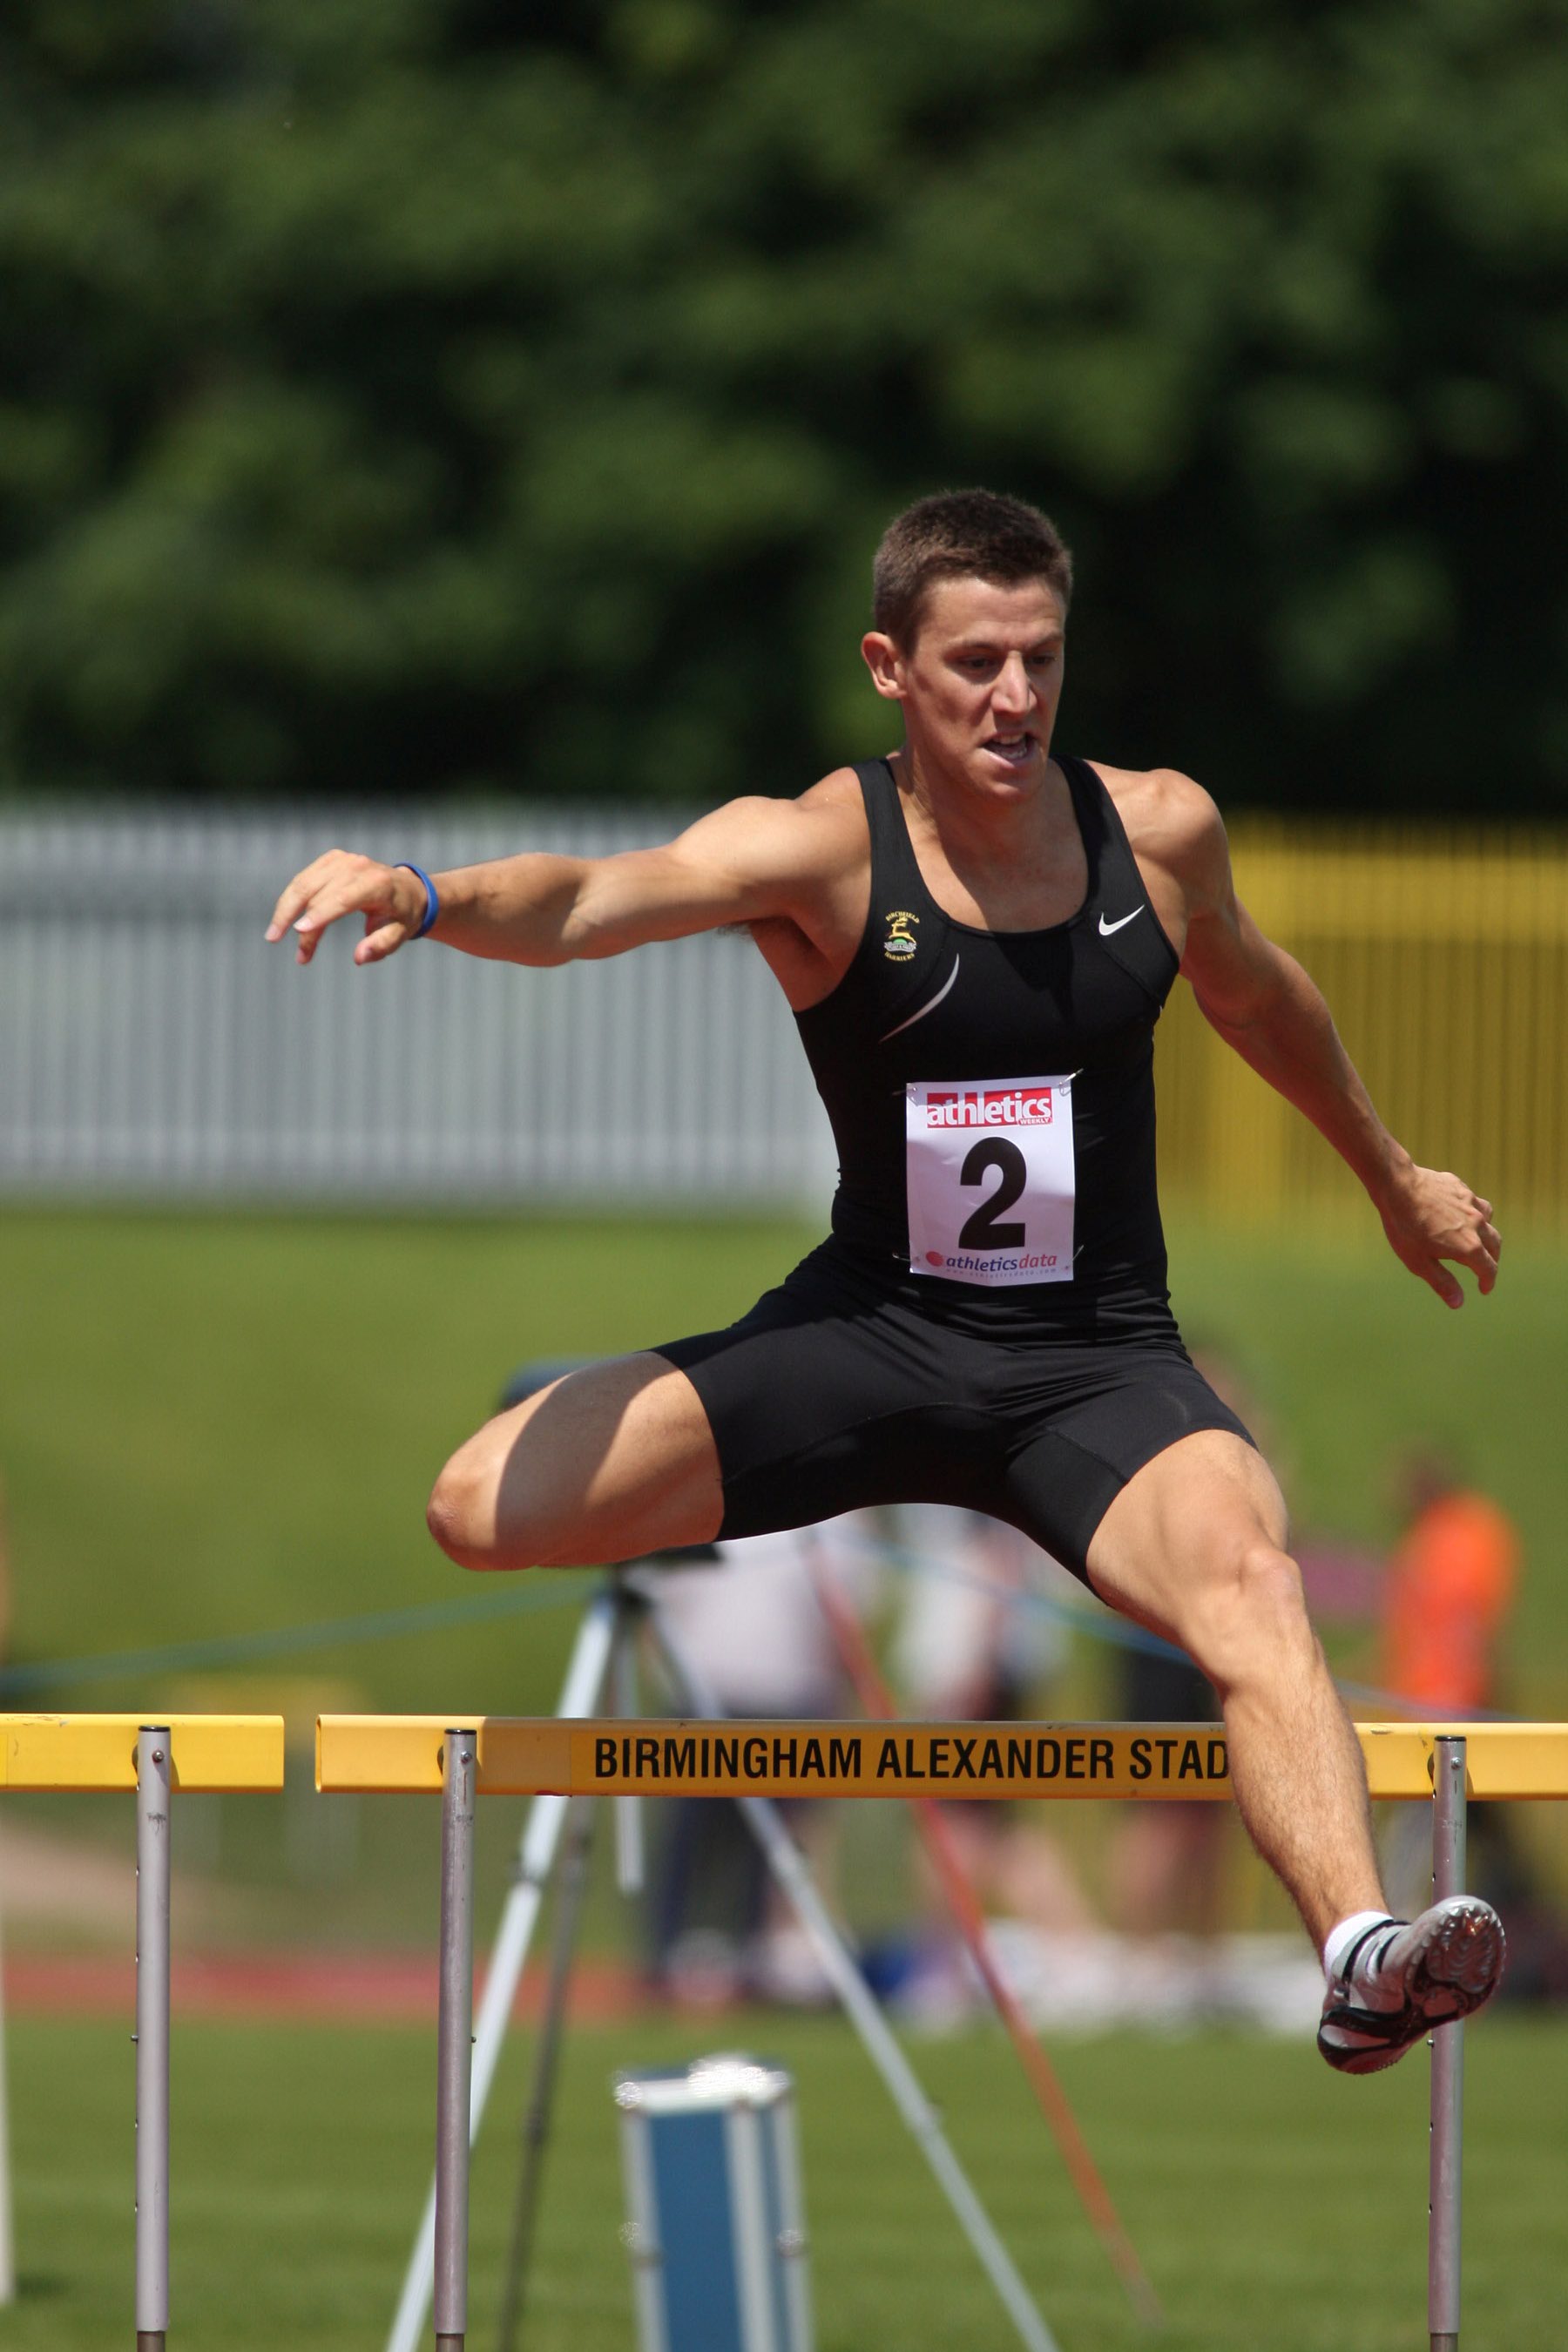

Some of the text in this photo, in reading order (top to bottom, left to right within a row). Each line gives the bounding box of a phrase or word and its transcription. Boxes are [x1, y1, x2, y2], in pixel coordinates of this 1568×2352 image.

[926, 1091, 1051, 1126] athletics
[1019, 1117, 1051, 1125] WEEKLY
[958, 1136, 1027, 1251] 2
[595, 1737, 862, 1779] BIRMINGHAM
[876, 1738, 1115, 1779] ALEXANDER
